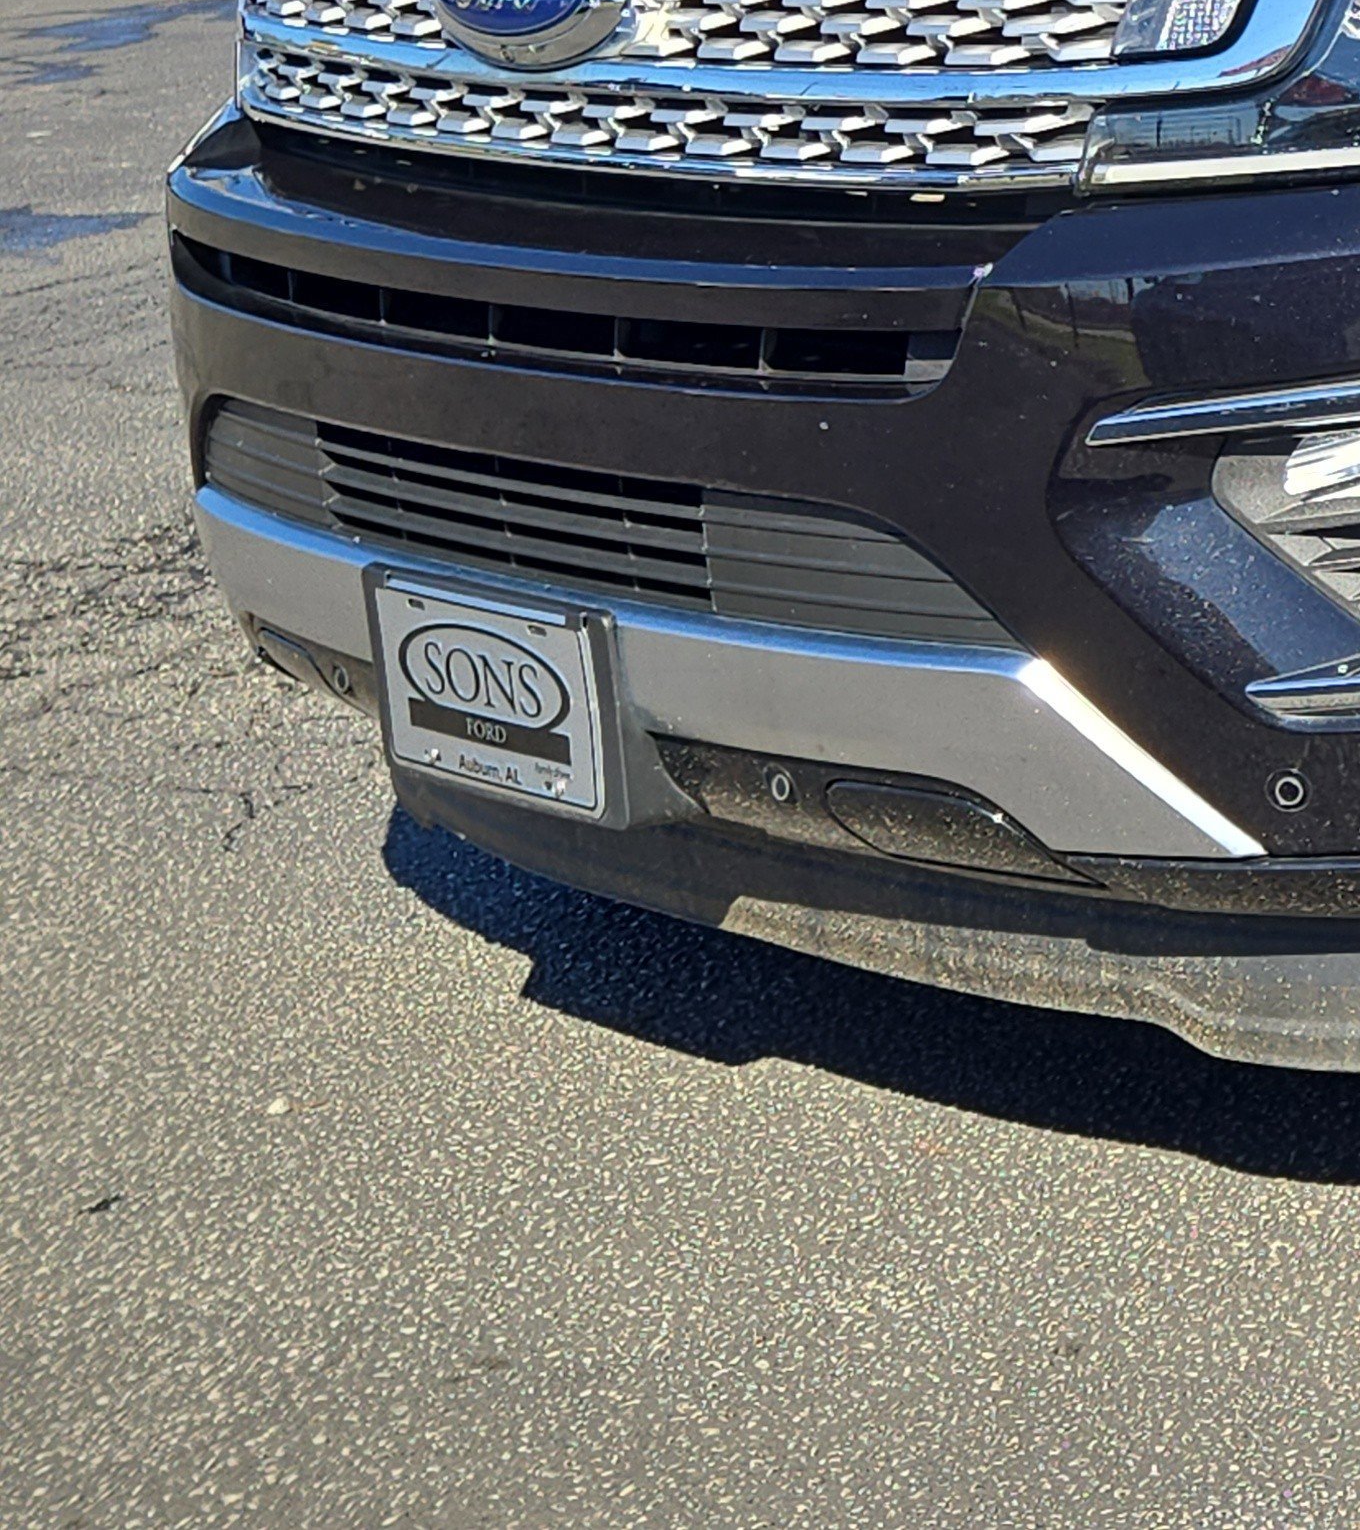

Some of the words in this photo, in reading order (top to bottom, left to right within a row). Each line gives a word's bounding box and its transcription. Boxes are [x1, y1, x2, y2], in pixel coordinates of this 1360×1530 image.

[423, 640, 544, 719] SONS
[465, 717, 507, 745] FORD
[458, 753, 503, 781] Auburn,
[505, 764, 523, 786] AL
